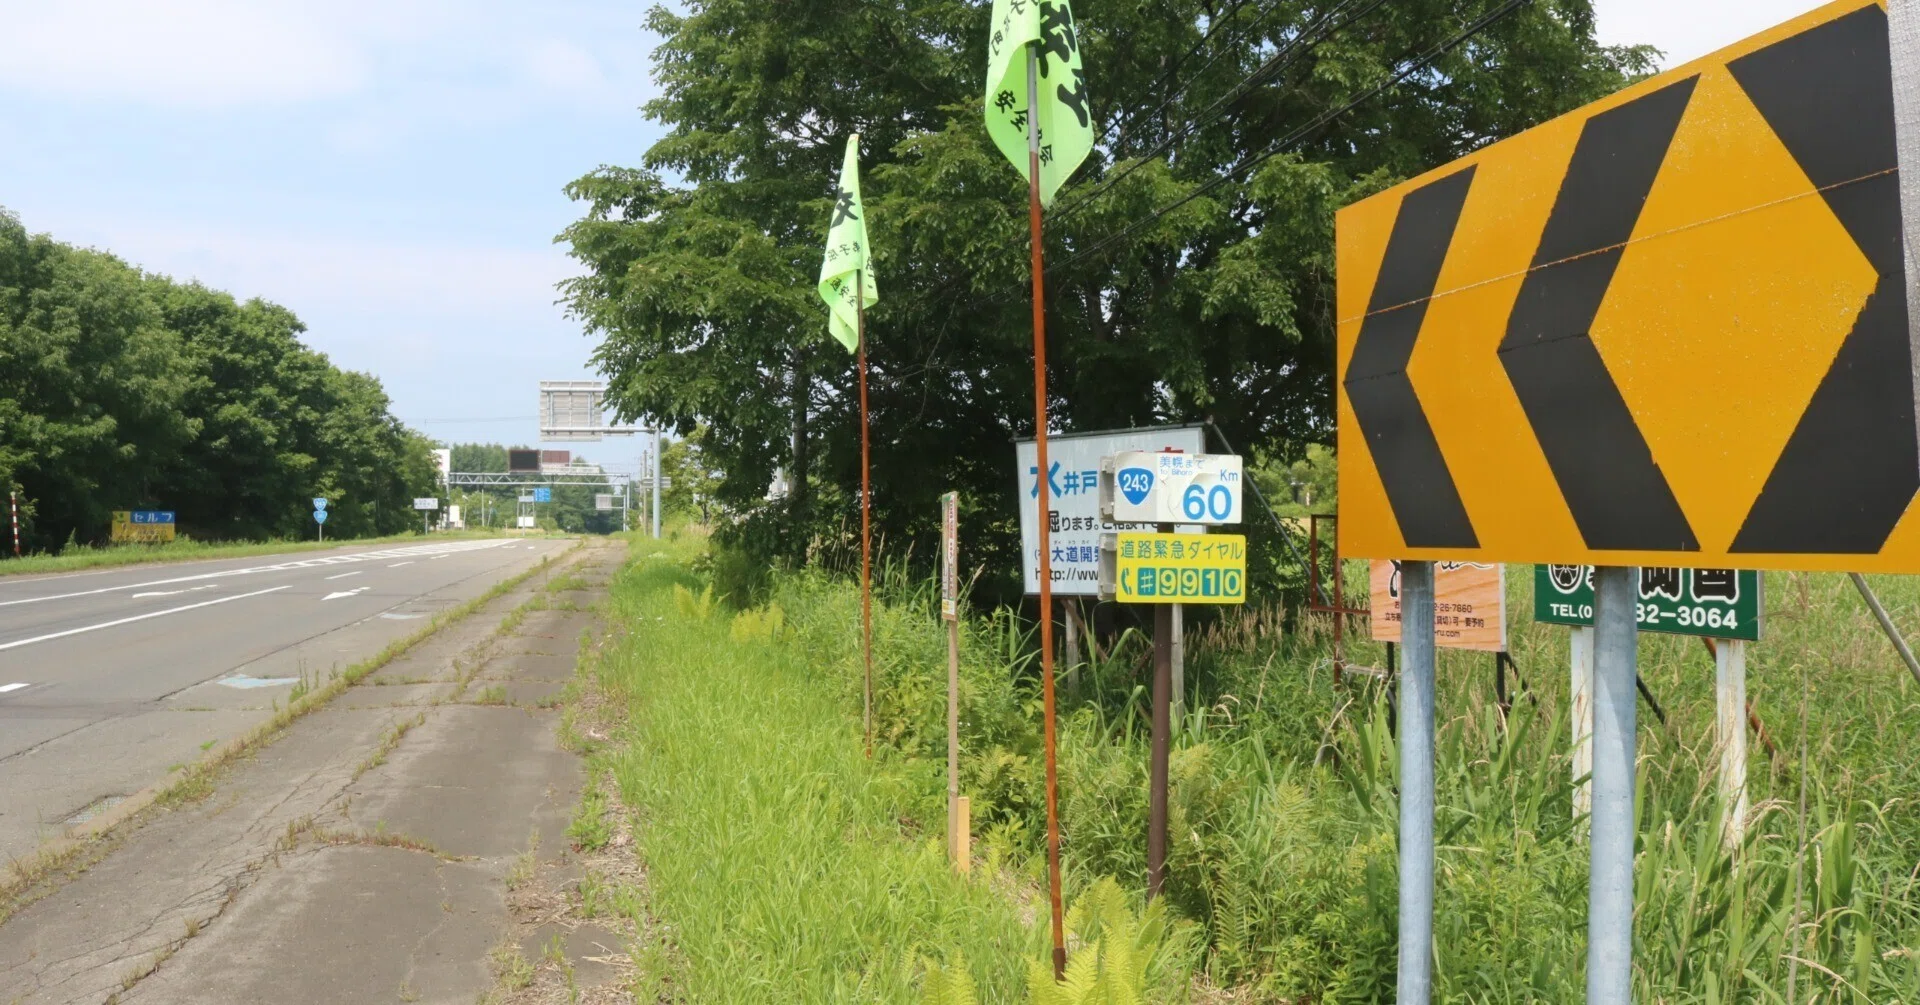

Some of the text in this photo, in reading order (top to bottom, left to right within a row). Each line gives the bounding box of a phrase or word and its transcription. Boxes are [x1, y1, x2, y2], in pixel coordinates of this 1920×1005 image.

[995, 90, 1054, 167] 安全会
[1123, 473, 1149, 492] 243
[1220, 470, 1239, 482] Km
[1182, 484, 1232, 520] 60
[134, 512, 172, 522] セルフ
[1120, 540, 1244, 560] 道路緊急ダイヤル
[1035, 567, 1098, 582] htp://ww
